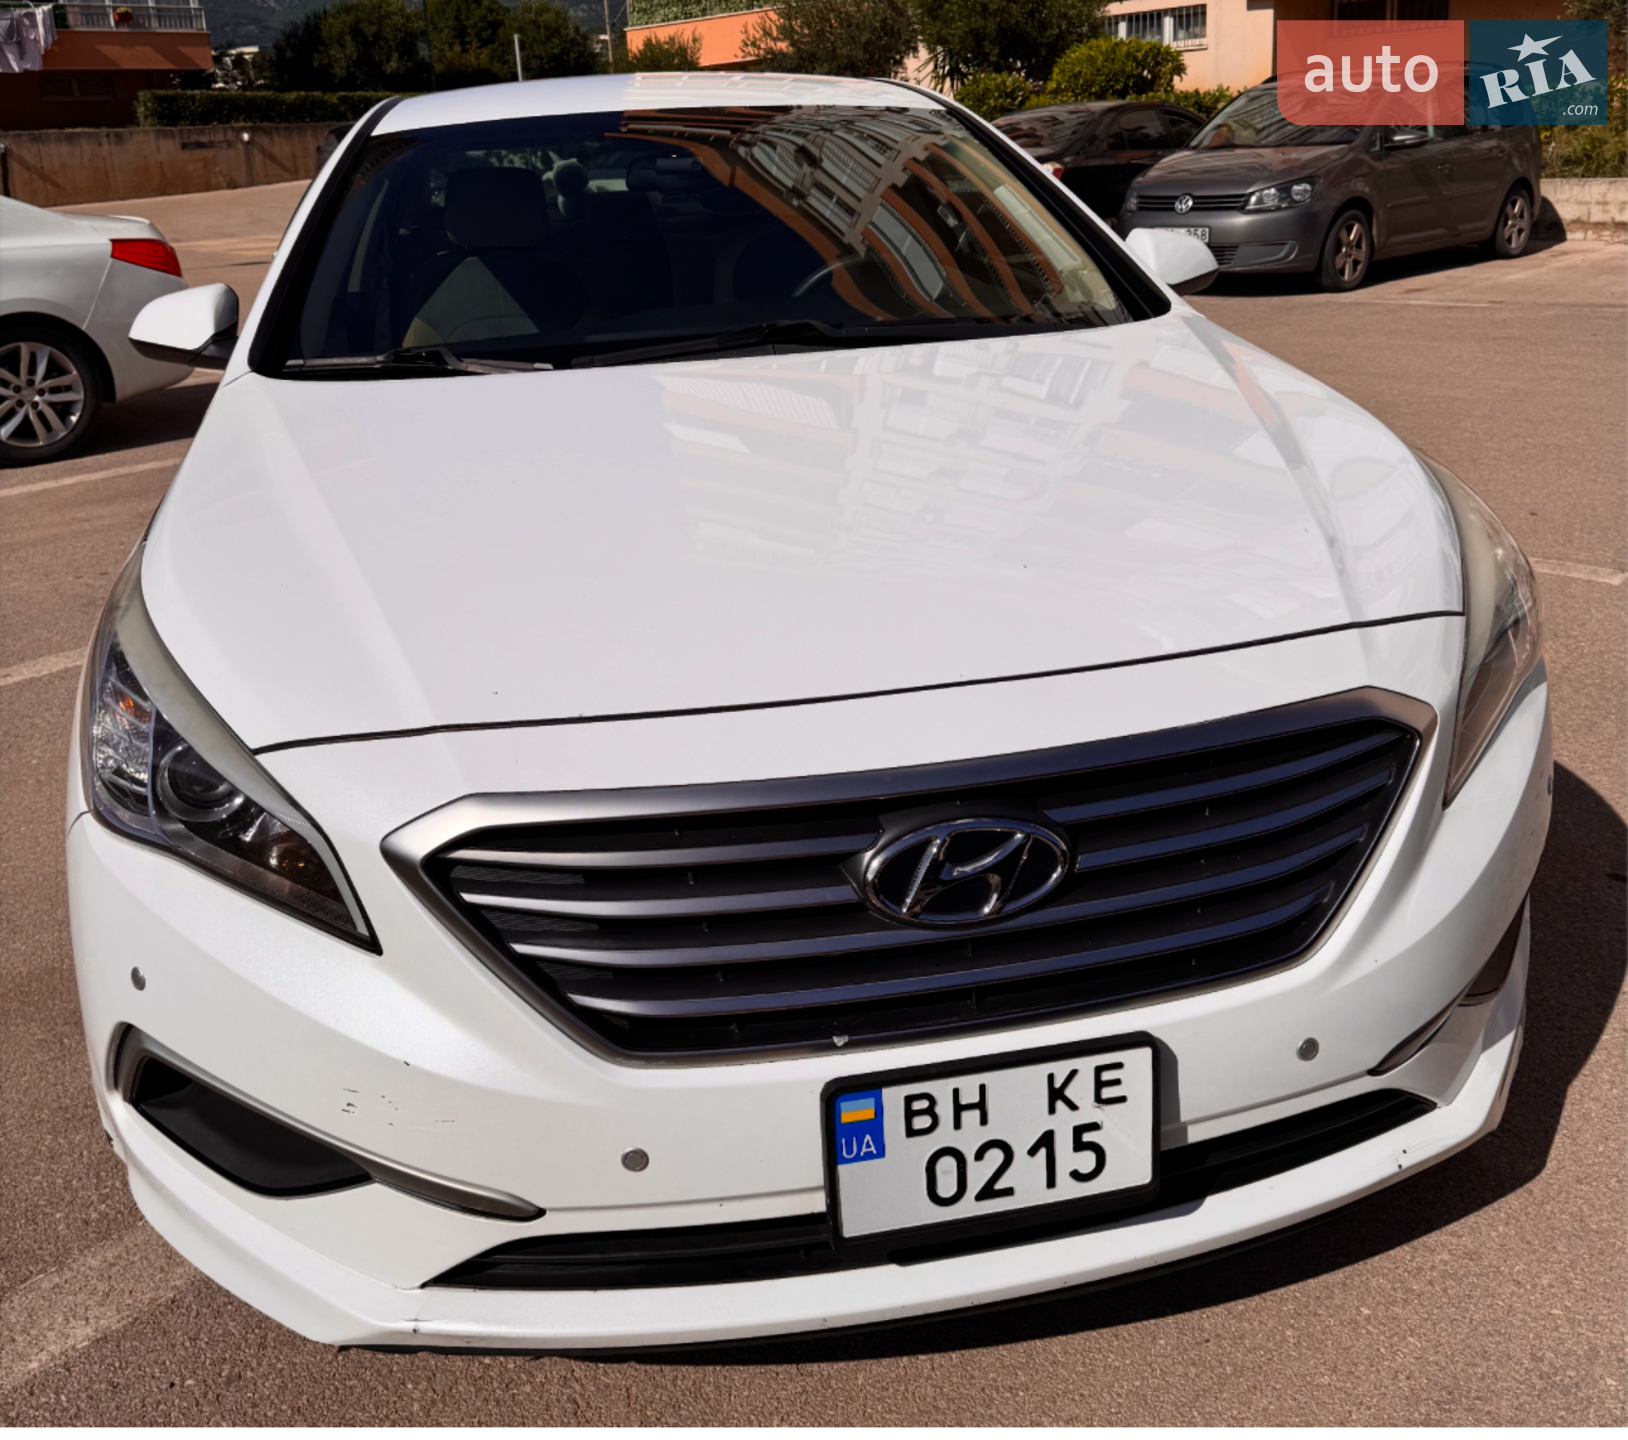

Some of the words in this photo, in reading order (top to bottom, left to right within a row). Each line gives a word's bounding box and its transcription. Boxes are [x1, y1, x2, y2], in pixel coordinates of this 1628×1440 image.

[903, 1083, 989, 1138] BH
[1046, 1061, 1128, 1115] KE
[841, 1134, 877, 1160] UA
[925, 1122, 1107, 1207] 0215
